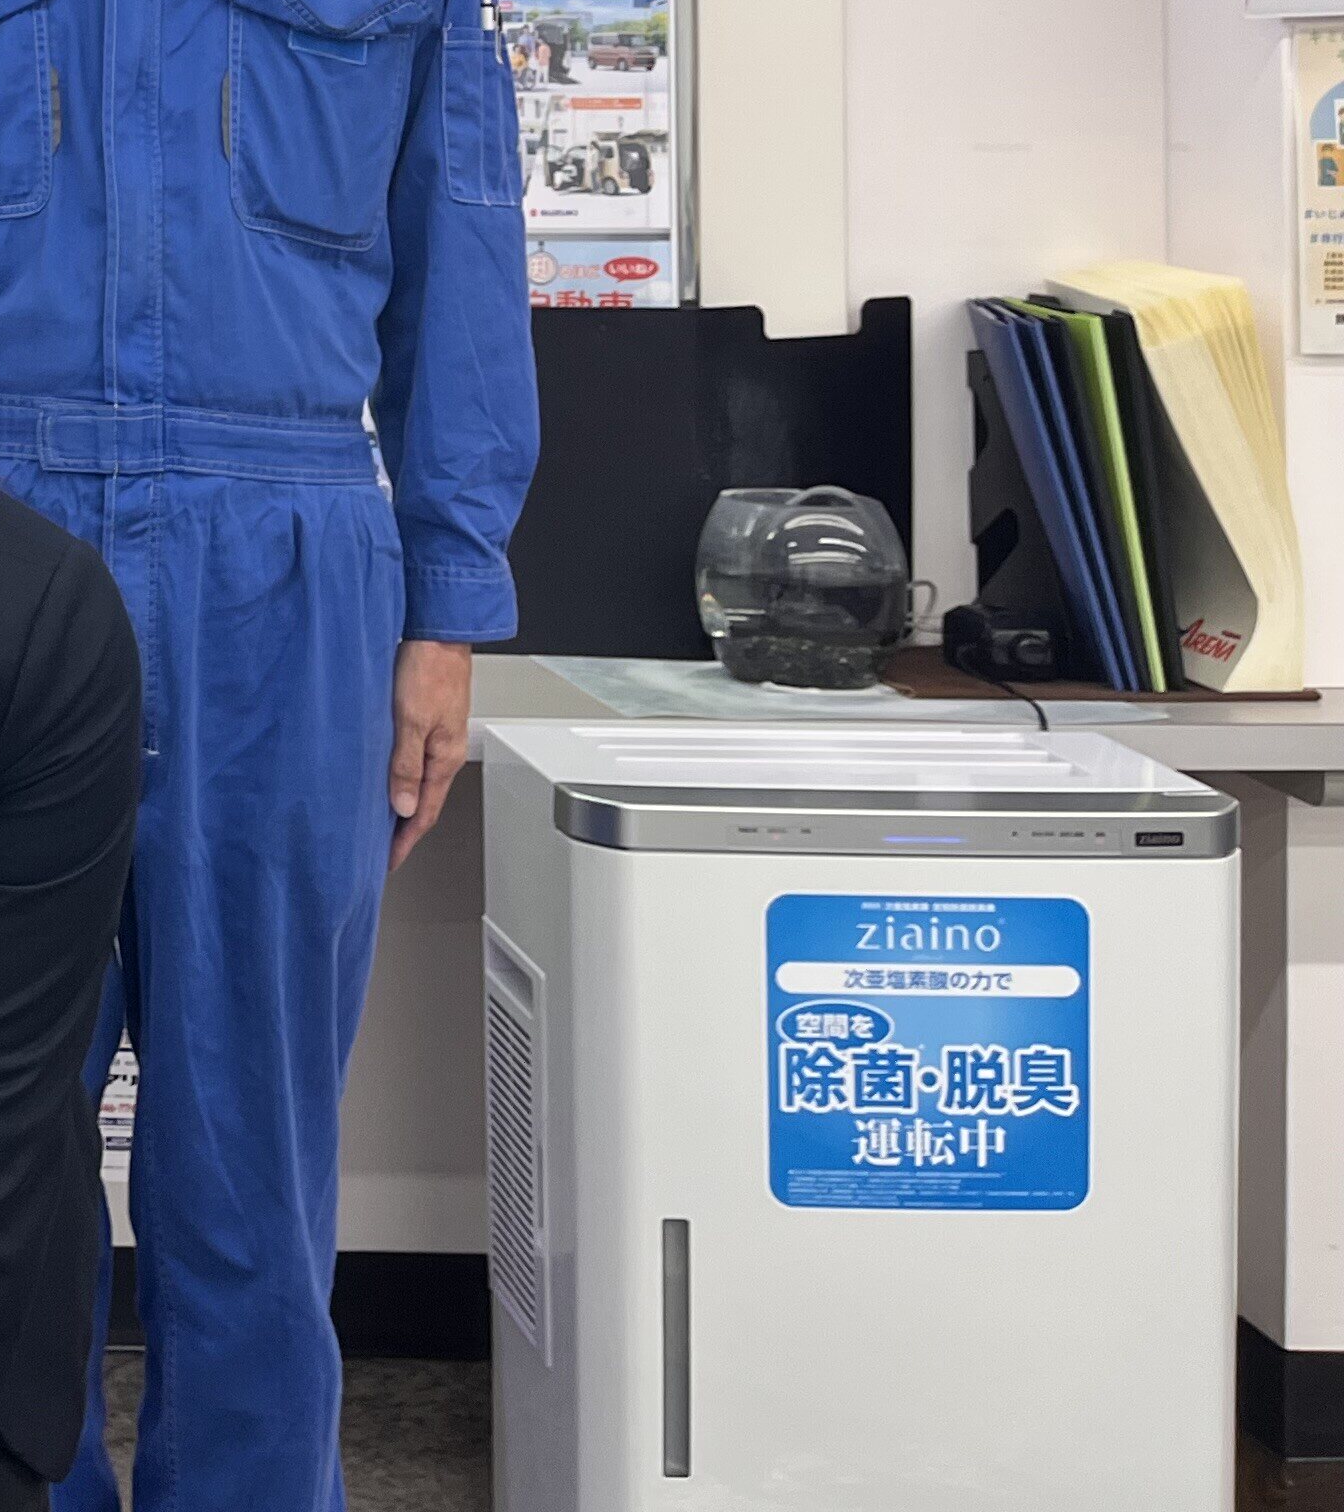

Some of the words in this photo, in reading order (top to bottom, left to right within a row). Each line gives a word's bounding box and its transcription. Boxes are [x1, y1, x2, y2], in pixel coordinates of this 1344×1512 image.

[855, 916, 1002, 952] ziaino
[843, 969, 1013, 991] 次亜塩素酸の力で
[795, 1014, 875, 1040] 空間を
[781, 1044, 1077, 1115] 除菌・脱臭
[852, 1118, 1007, 1168] 運転中
